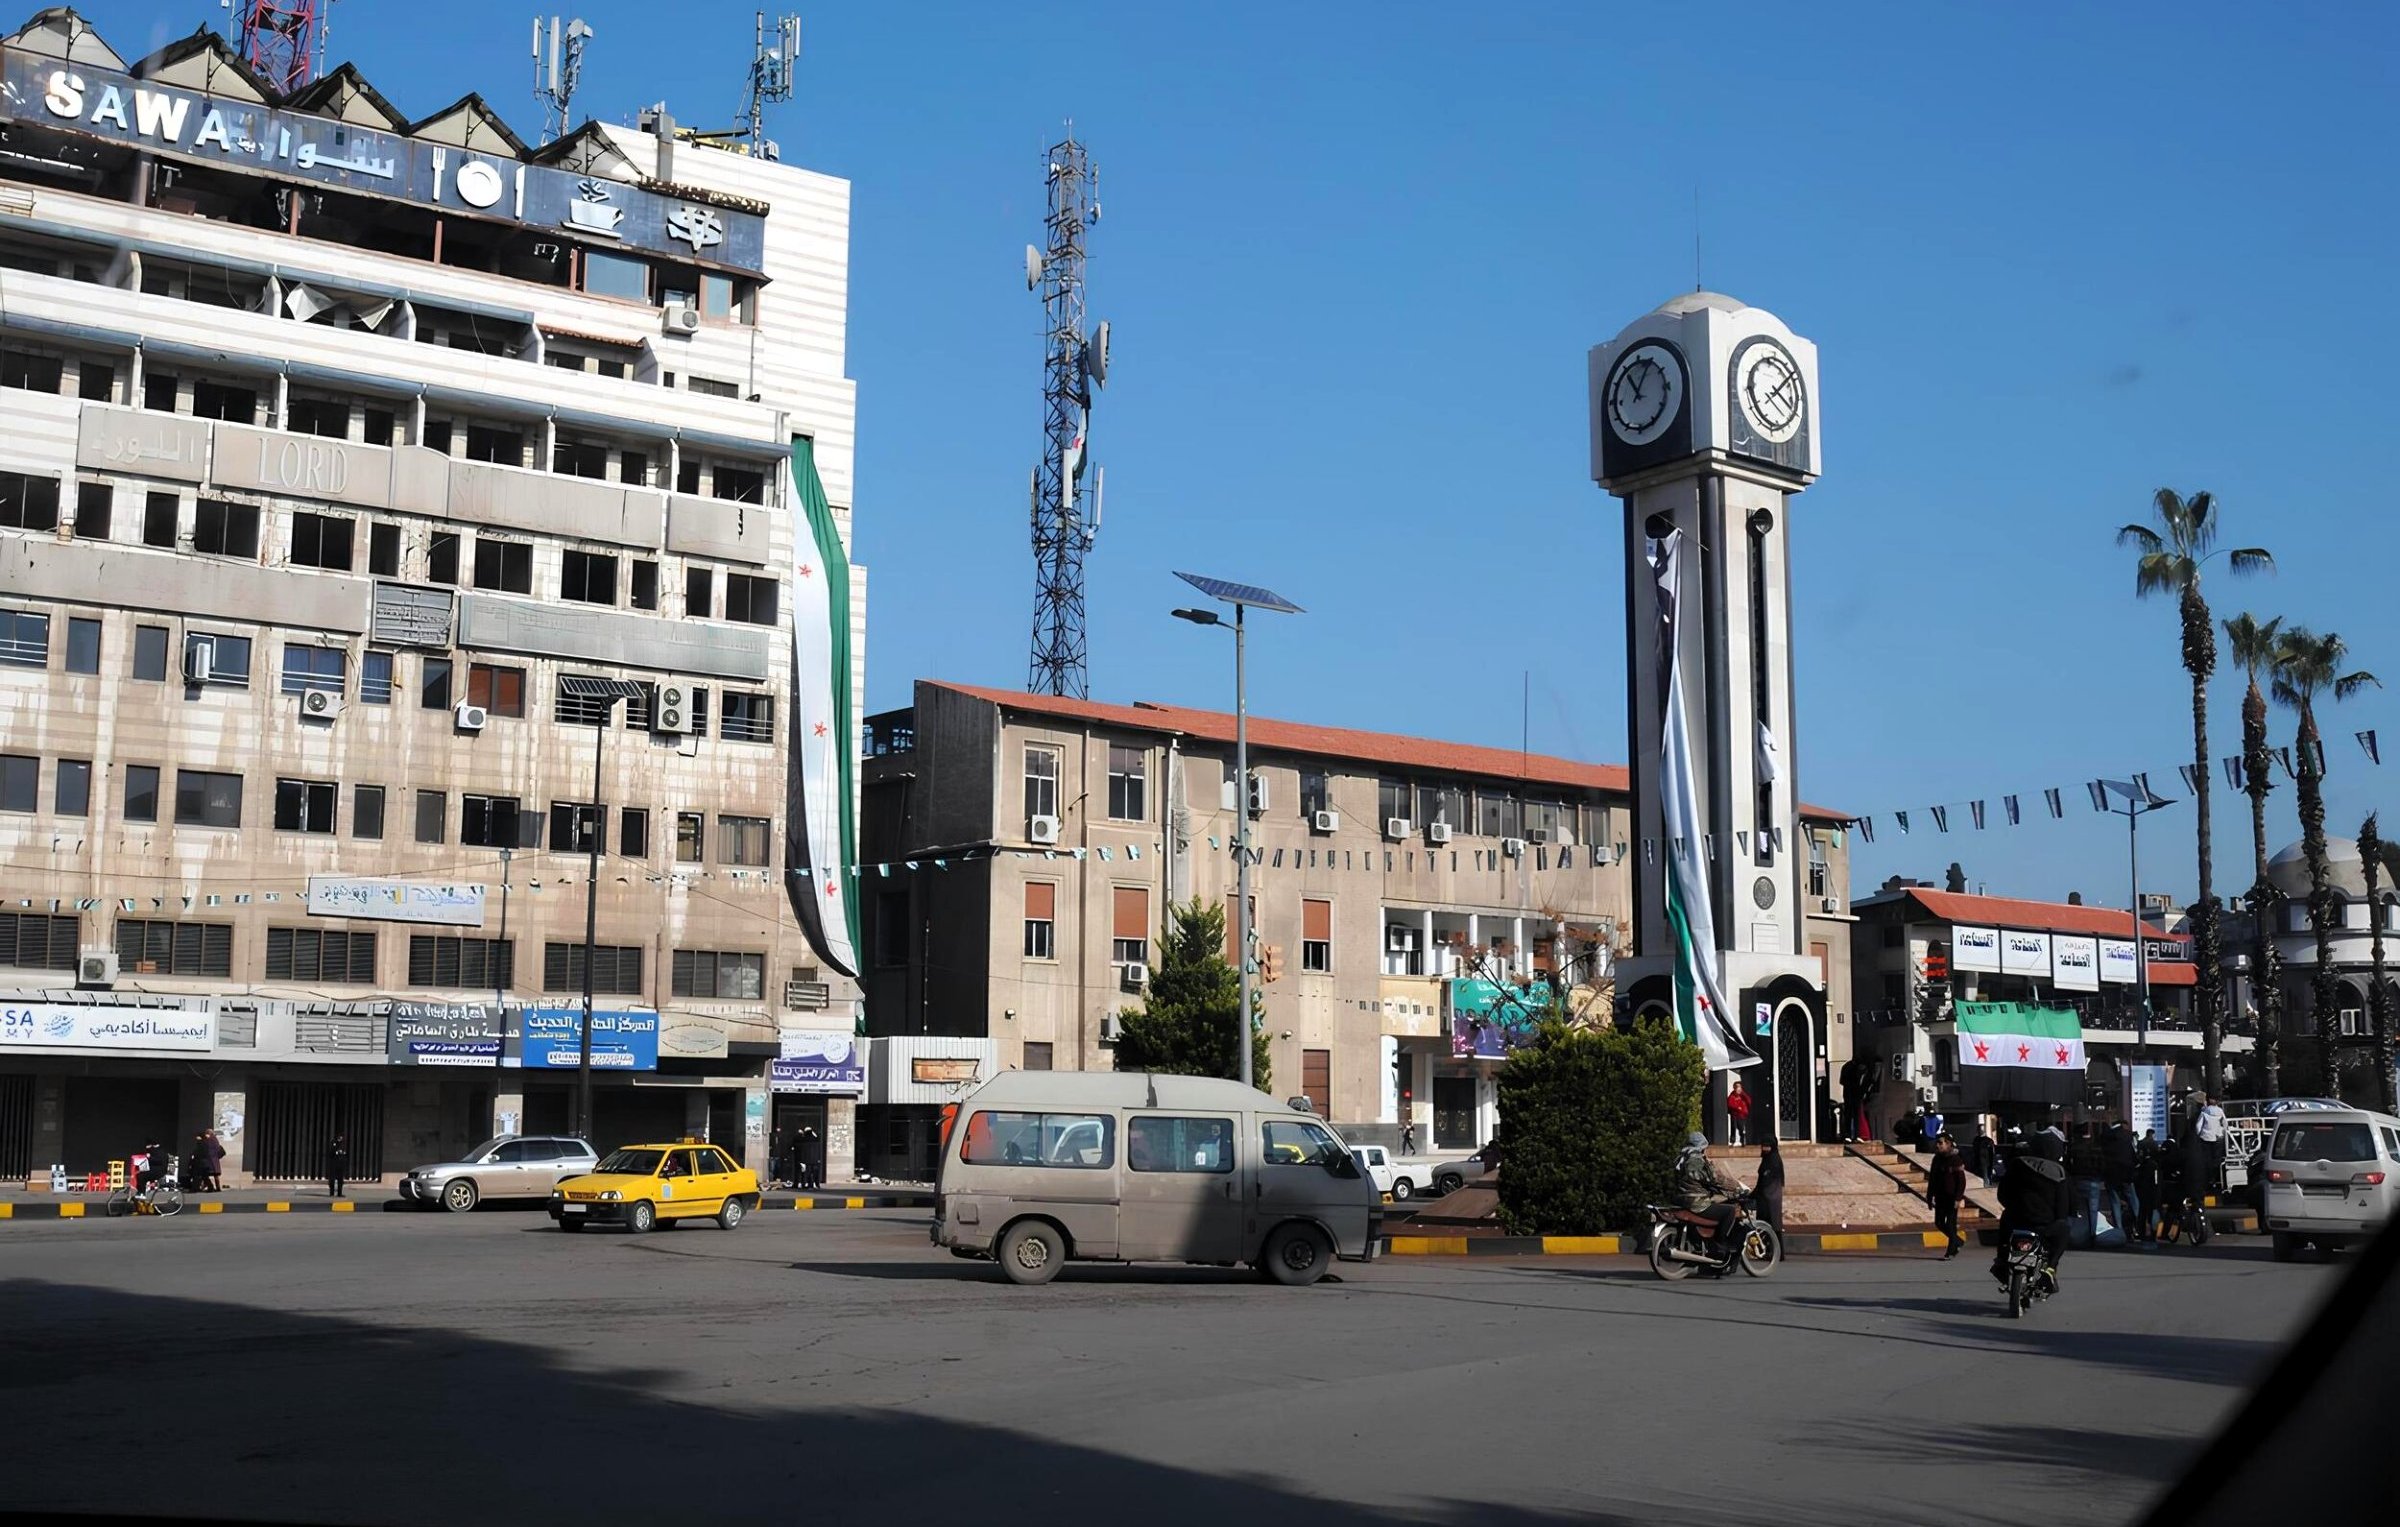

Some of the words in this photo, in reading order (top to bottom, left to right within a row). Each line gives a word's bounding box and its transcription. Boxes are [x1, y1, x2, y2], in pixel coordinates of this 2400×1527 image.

[45, 70, 230, 151] SAWA
[258, 436, 346, 494] LORD
[0, 1009, 33, 1026] SA
[528, 1011, 573, 1031] الحديث
[616, 1015, 655, 1033] المركز
